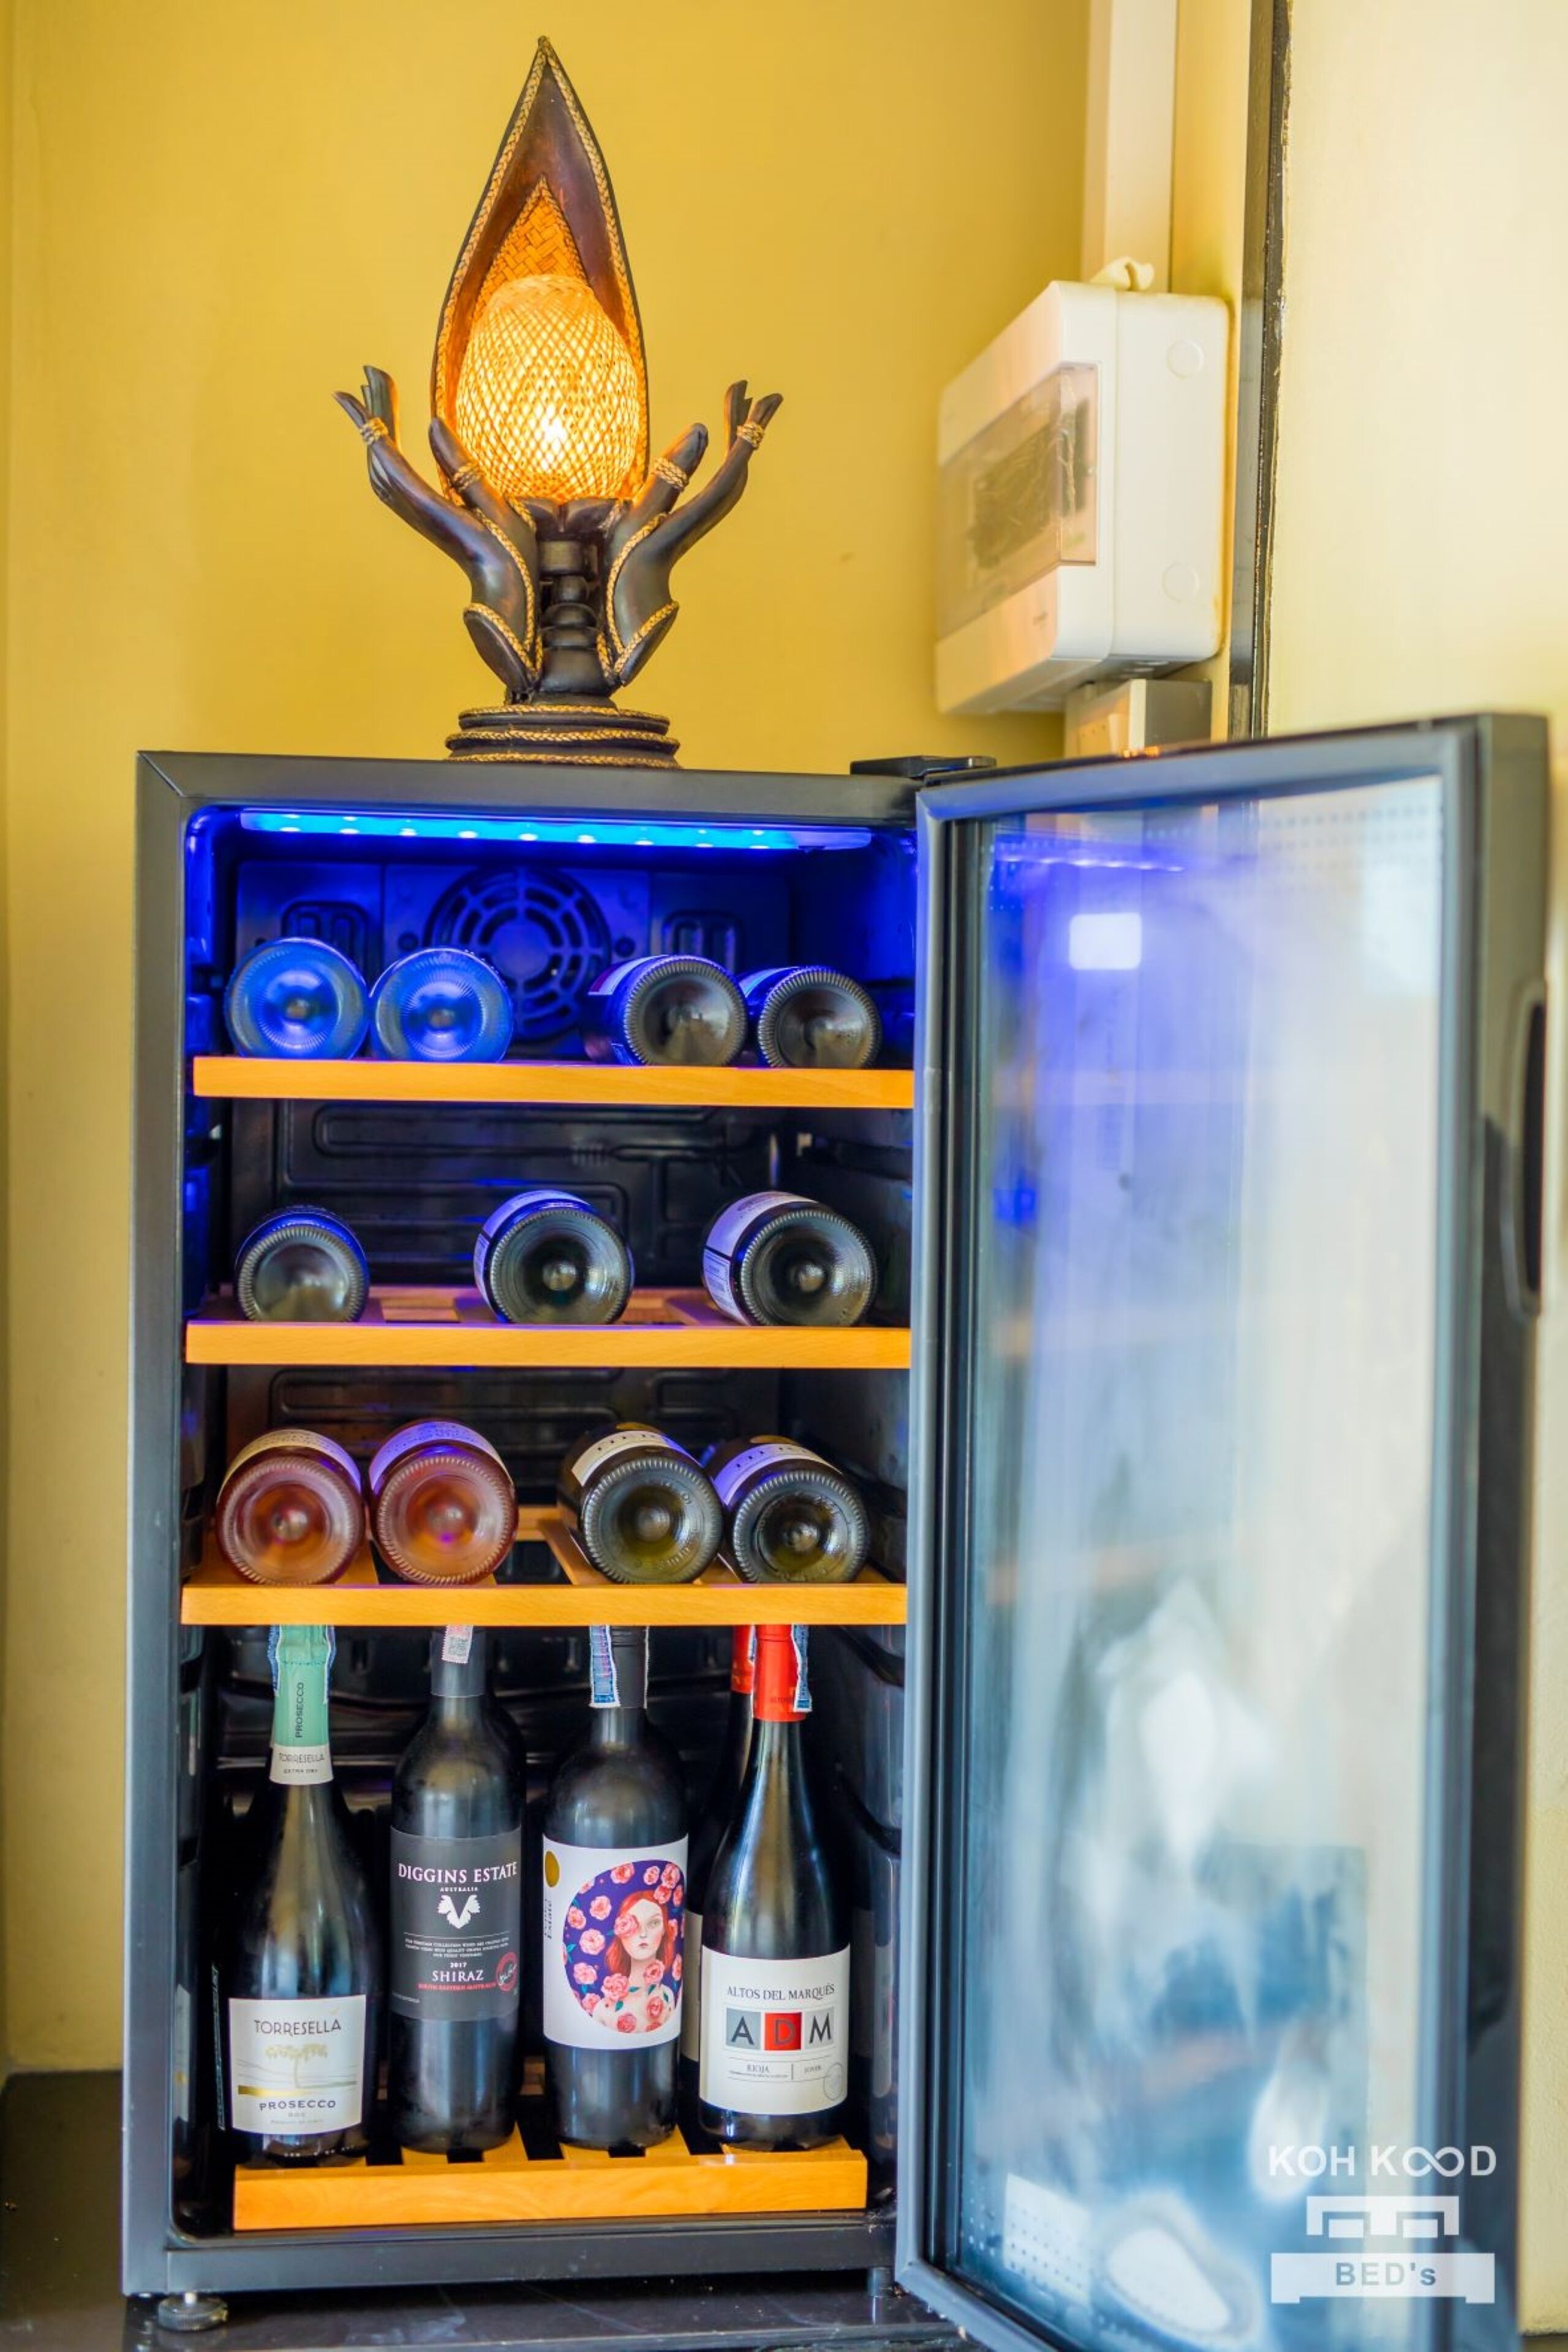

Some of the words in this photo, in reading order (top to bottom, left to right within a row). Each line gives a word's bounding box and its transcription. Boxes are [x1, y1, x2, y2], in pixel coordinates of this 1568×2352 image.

[295, 1683, 304, 1738] PROSECCO
[398, 1863, 467, 1884] DIGGINS
[473, 1861, 518, 1883] ESTATE
[432, 1970, 484, 1982] SHIRAZ
[728, 1986, 760, 1999] ALTOS
[763, 1990, 785, 2000] DEL
[254, 2019, 341, 2037] TORRESELLA
[259, 2100, 336, 2111] PROSECCO
